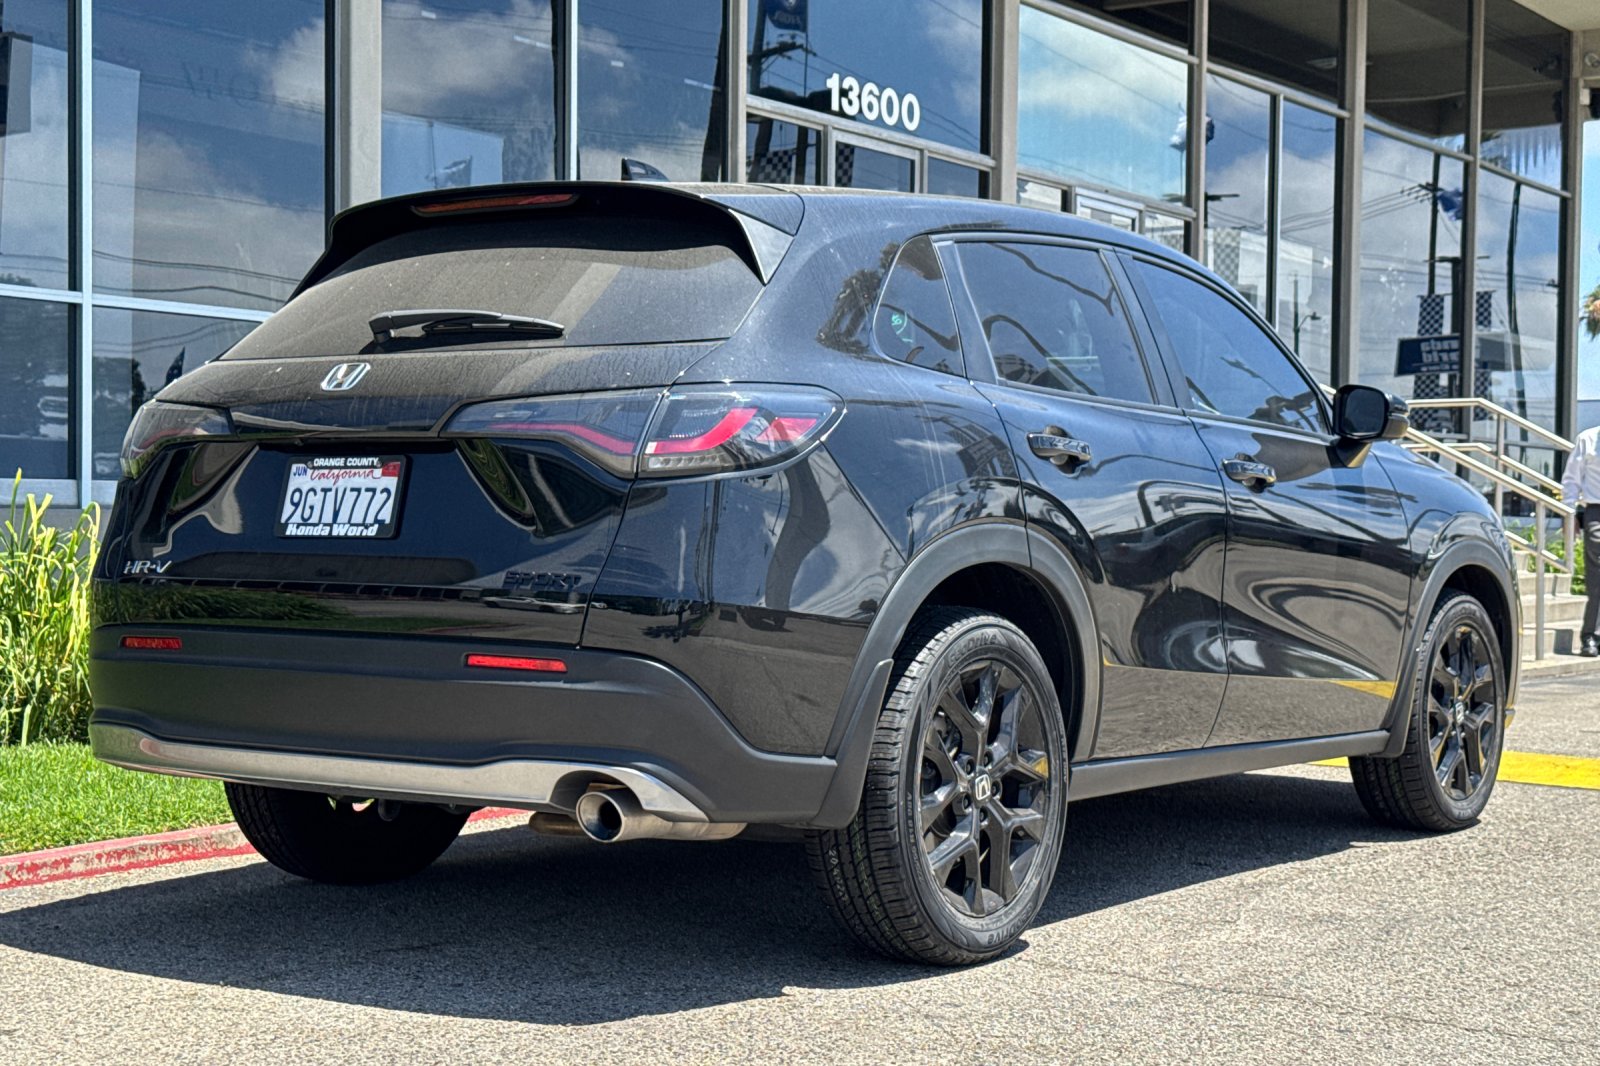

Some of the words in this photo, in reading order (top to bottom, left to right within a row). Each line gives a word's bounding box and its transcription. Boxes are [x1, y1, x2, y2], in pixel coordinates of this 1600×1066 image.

[826, 72, 920, 131] 13600
[313, 458, 345, 467] ORANGE
[346, 457, 379, 466] COUNTY
[292, 466, 308, 477] JUN
[310, 468, 382, 486] California
[285, 487, 392, 525] 9GTV772
[285, 523, 331, 536] Honda
[123, 560, 172, 574] HR-V
[502, 570, 582, 592] SPORT
